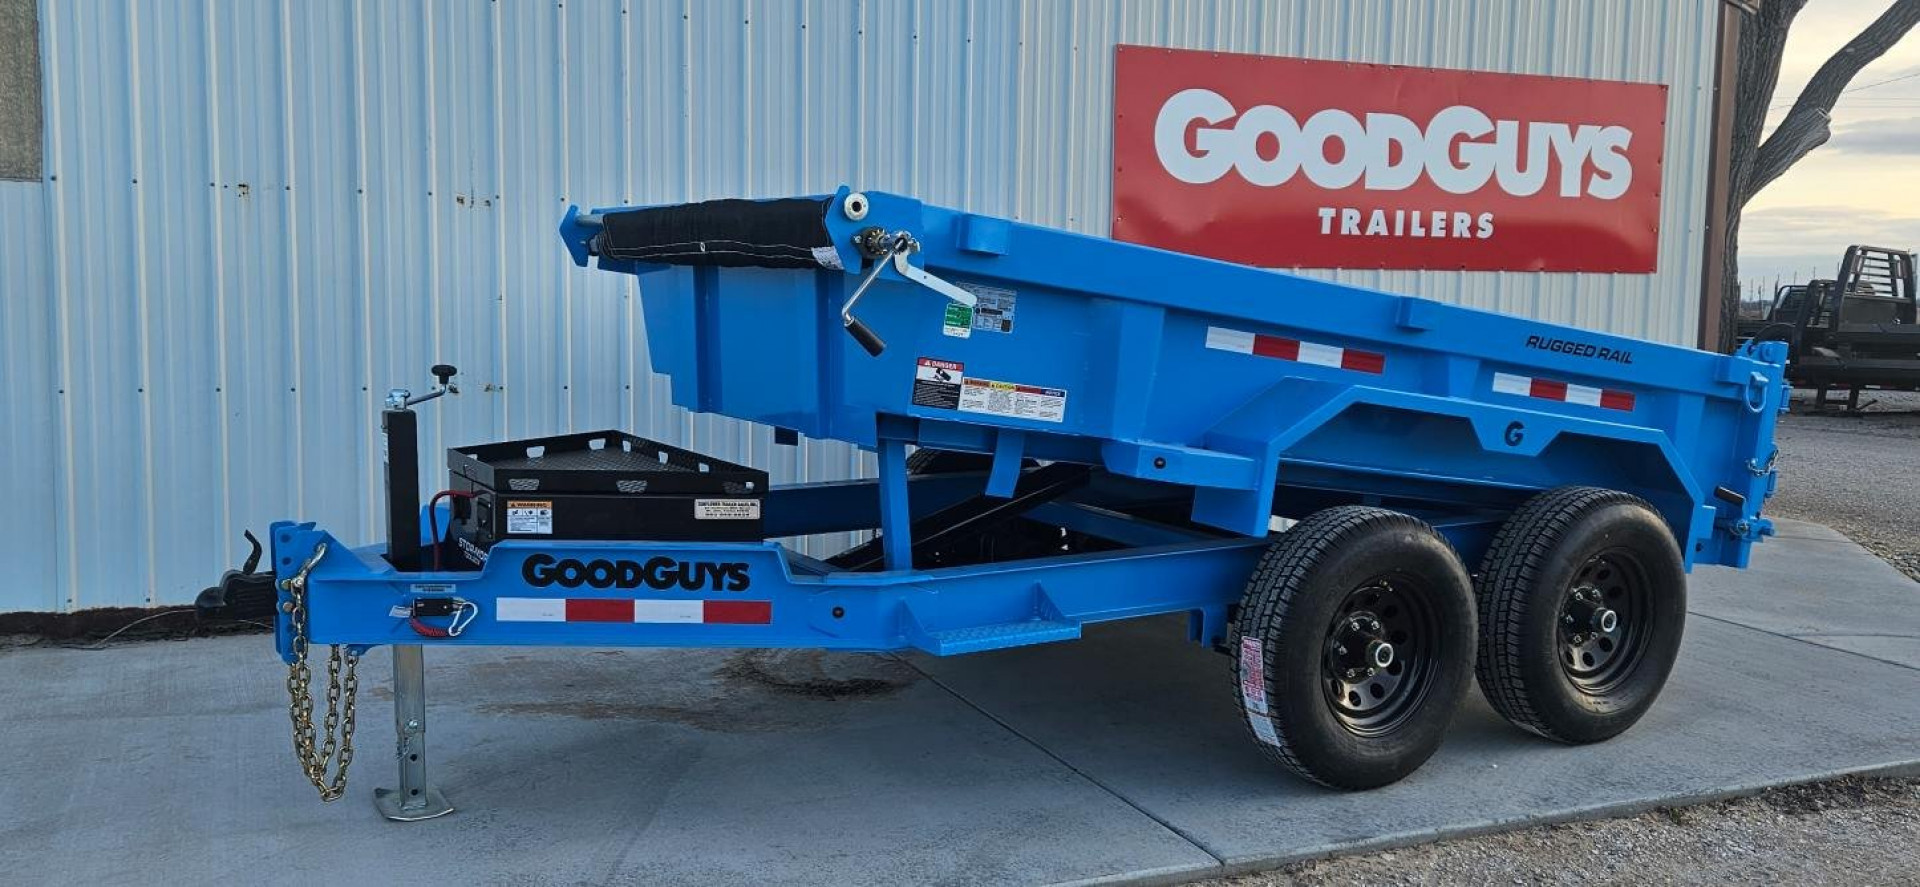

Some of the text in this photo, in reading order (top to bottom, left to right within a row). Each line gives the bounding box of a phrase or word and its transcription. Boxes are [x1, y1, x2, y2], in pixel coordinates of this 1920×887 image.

[1154, 88, 1634, 200] GOODGUYS
[1318, 207, 1495, 239] TRAILERS
[931, 360, 957, 370] DANGER
[1526, 335, 1633, 365] RUGGED RAIL
[1505, 420, 1524, 447] G
[521, 553, 751, 592] GOODGUYS
